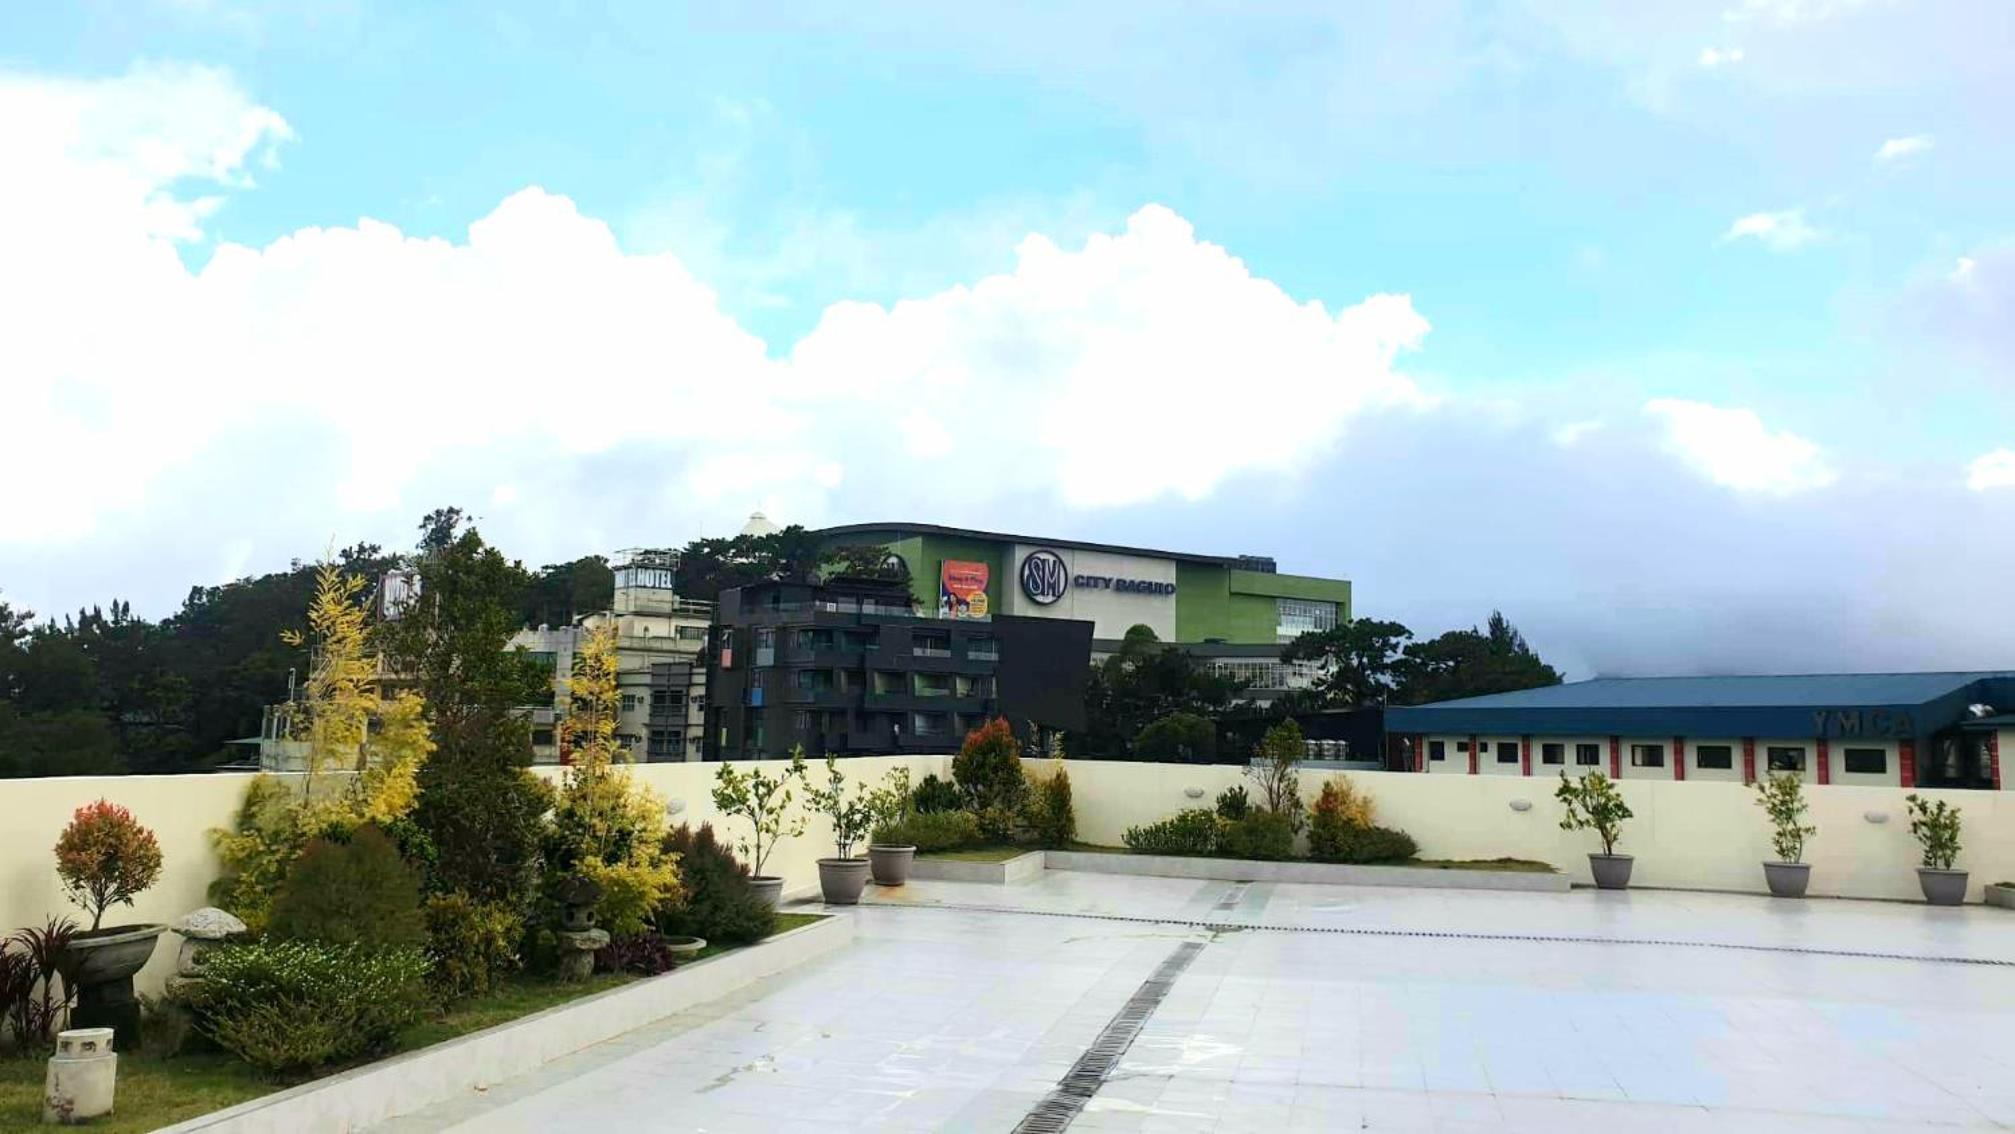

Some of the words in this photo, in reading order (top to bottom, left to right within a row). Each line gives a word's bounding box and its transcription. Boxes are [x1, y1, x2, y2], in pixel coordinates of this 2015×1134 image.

[638, 568, 672, 588] HOTEL
[1025, 555, 1062, 597] SM
[1074, 575, 1114, 590] CITY
[1115, 579, 1176, 595] BAGUIO
[1813, 711, 1914, 736] YMCA
